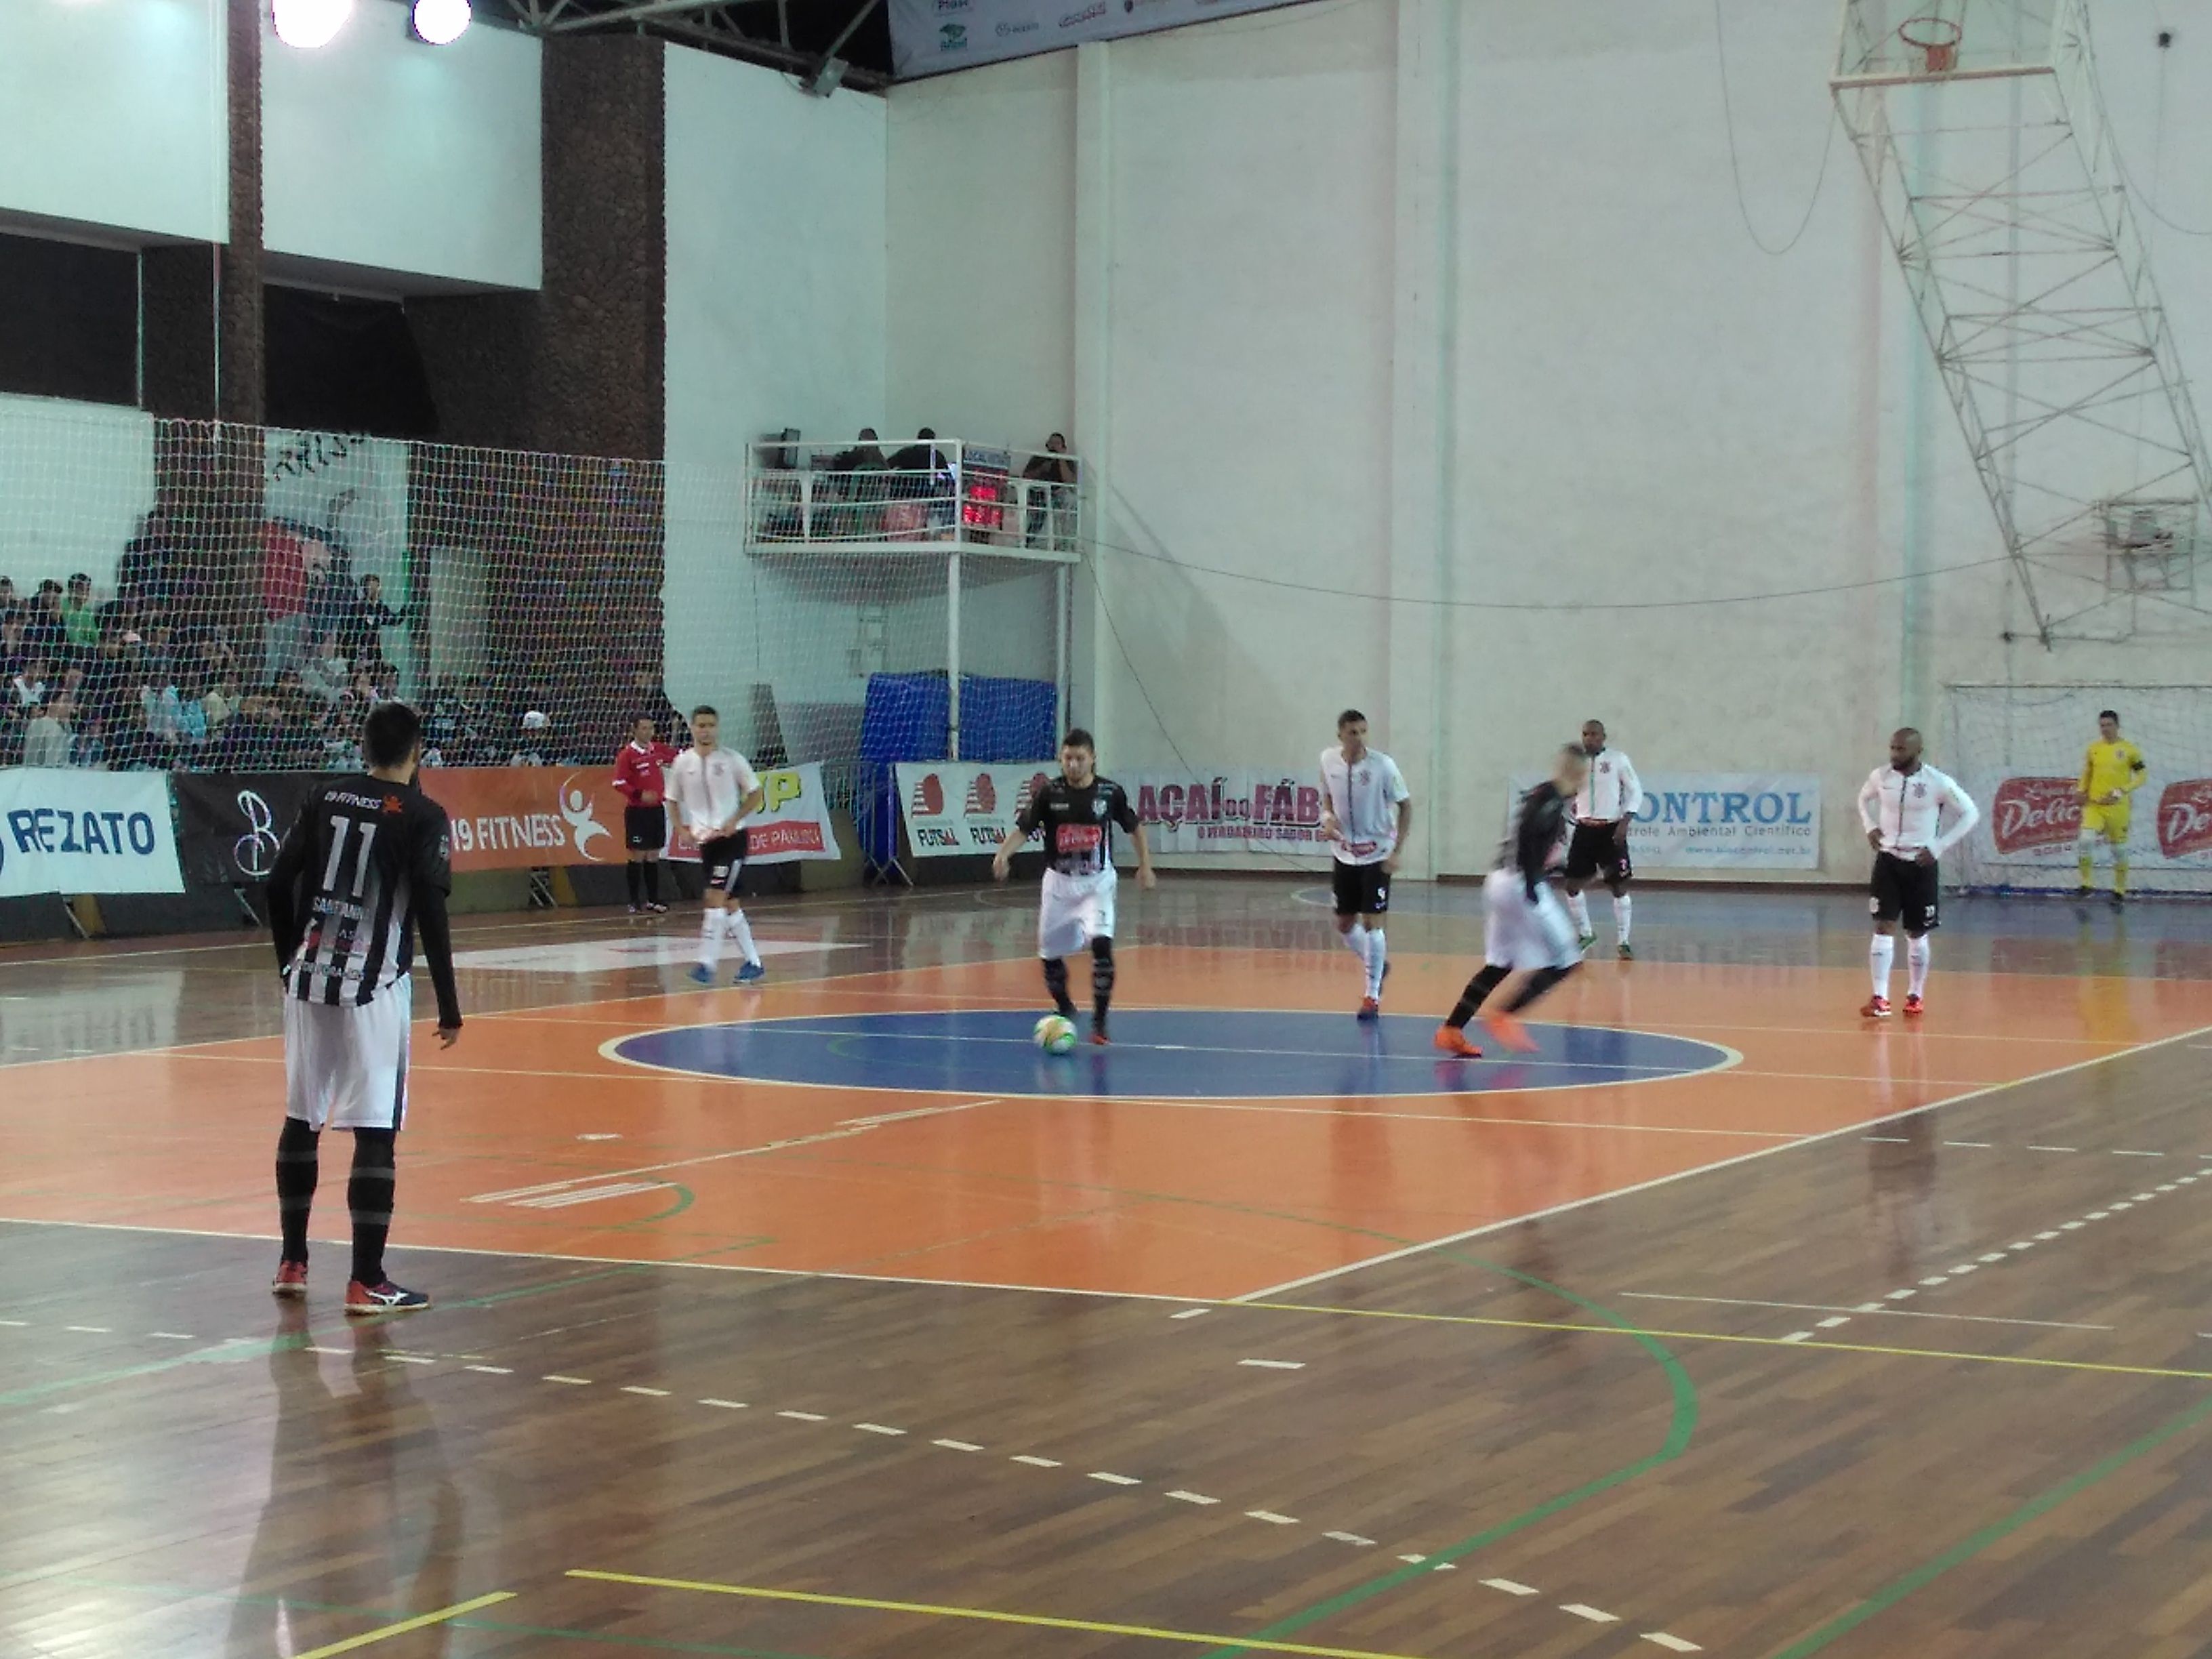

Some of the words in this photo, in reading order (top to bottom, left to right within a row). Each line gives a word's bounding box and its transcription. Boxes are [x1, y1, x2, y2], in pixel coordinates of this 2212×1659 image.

[1254, 778, 1319, 823] FÁB
[1633, 791, 1811, 824] ONTROL
[7, 808, 155, 855] REZATO
[450, 818, 473, 852] 19
[476, 814, 566, 851] FITNESS
[1667, 824, 1736, 838] Ambiental
[322, 815, 377, 898] 11
